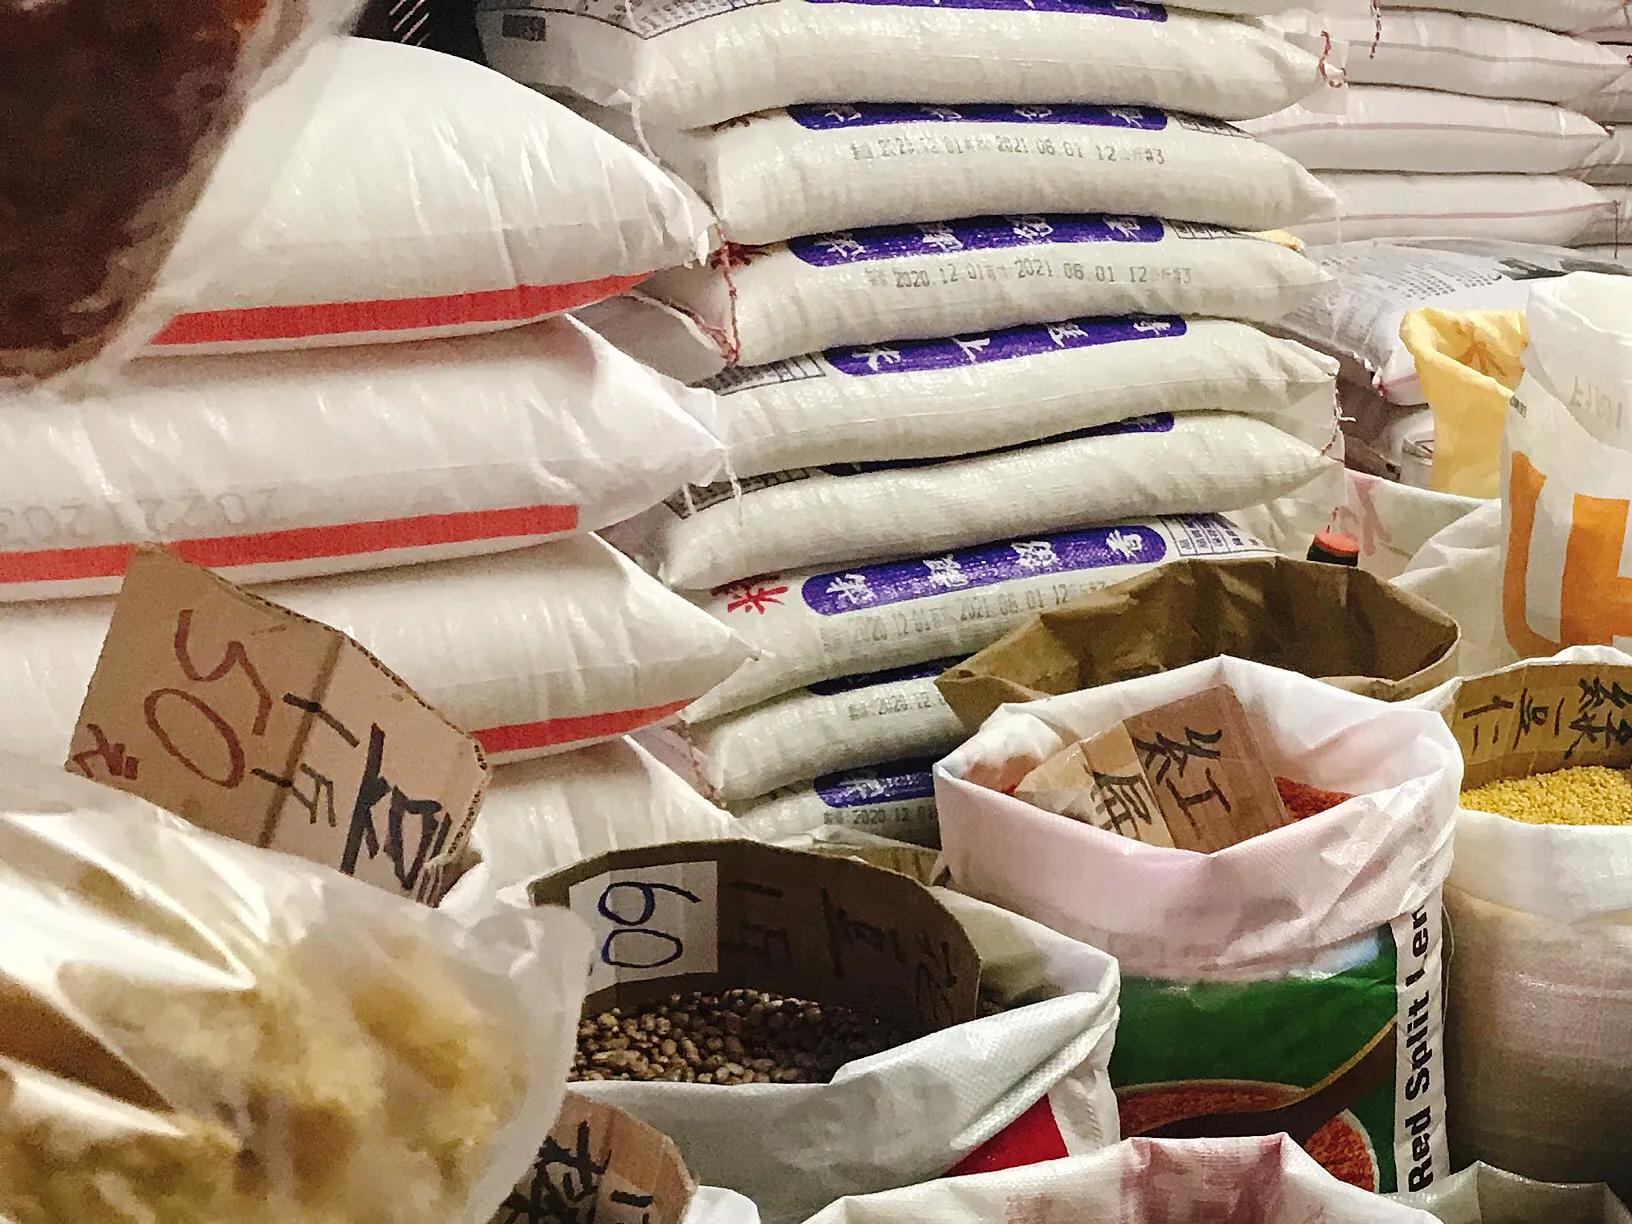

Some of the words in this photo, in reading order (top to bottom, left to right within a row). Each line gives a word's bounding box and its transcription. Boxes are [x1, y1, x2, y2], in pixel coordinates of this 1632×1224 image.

[1128, 265, 1148, 283] 12
[144, 609, 274, 790] 50
[599, 880, 701, 968] 60
[1405, 991, 1433, 1101] Split
[1405, 1107, 1434, 1192] Red
